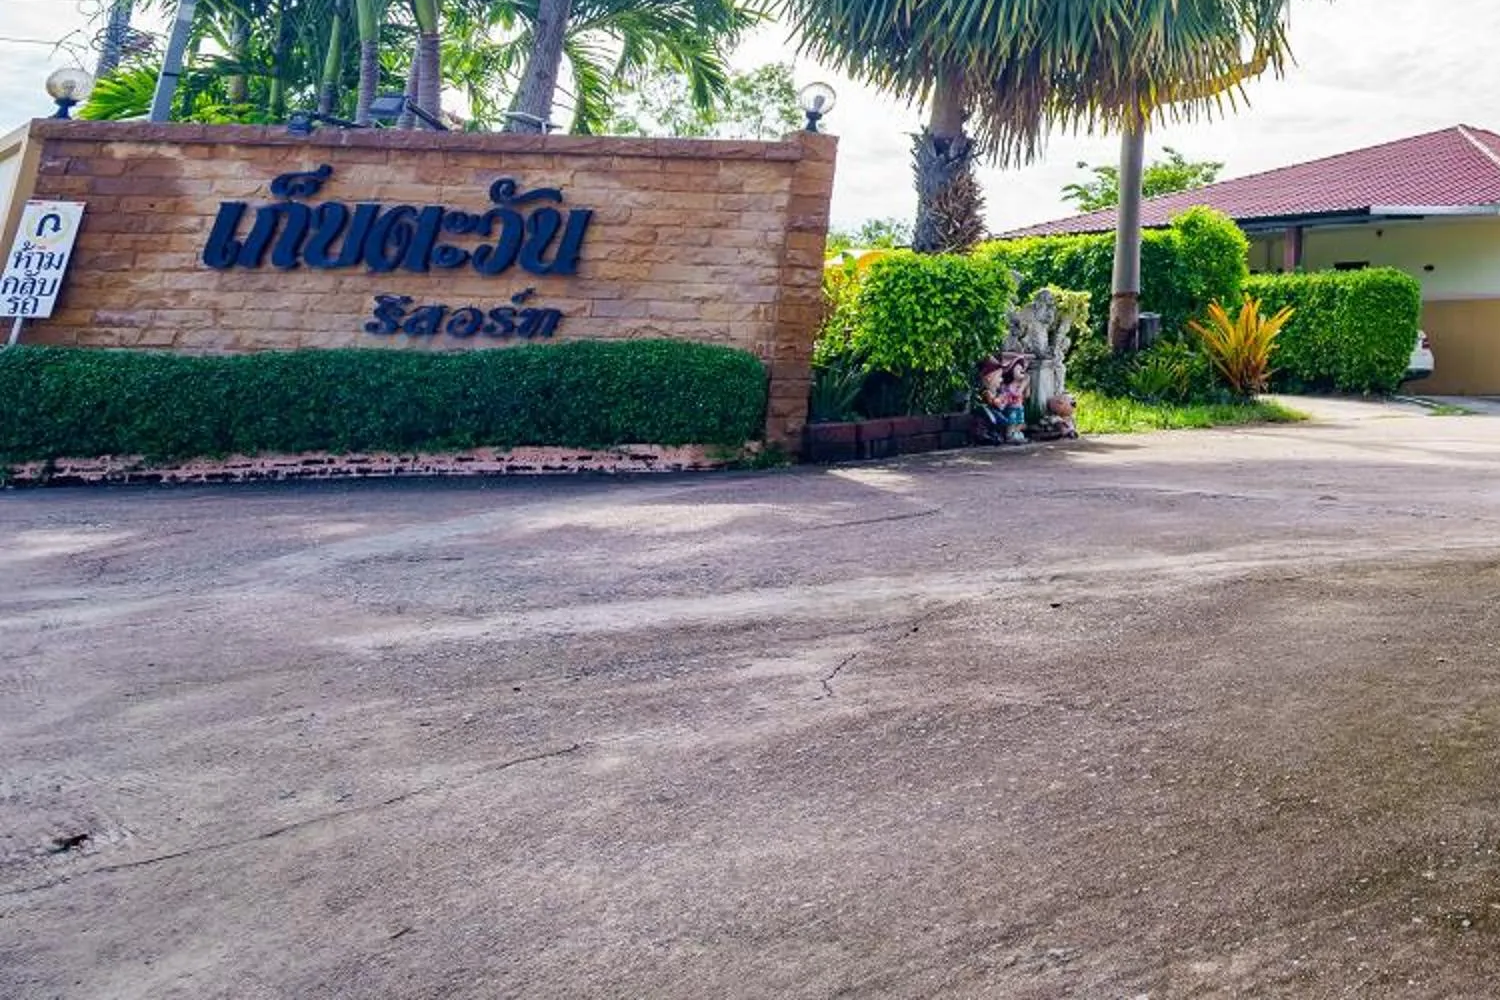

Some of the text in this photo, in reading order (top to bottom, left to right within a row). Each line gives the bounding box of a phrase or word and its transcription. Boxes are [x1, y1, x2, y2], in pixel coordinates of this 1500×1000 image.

[202, 164, 593, 276] เก็บตะวัน
[13, 241, 65, 271] ห้าม
[1, 269, 58, 297] กลับ
[6, 296, 39, 315] รถ
[364, 287, 563, 339] รีสอร์ท
